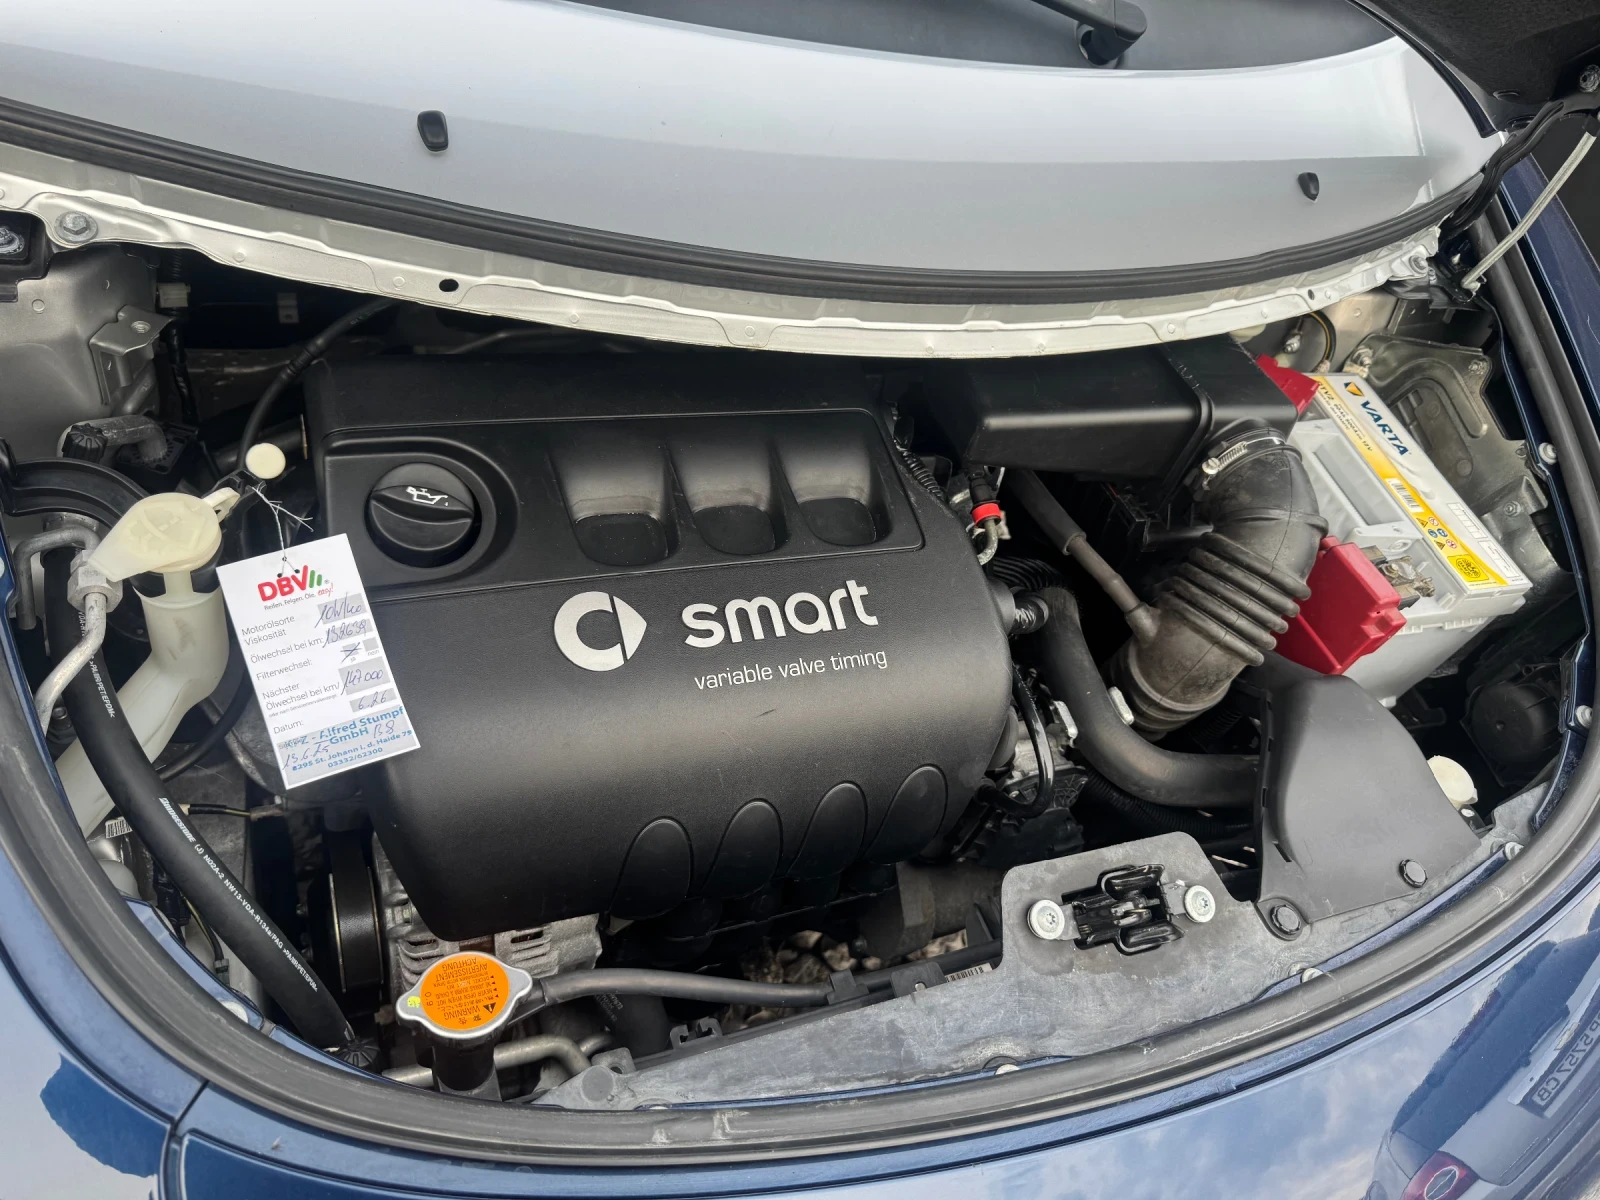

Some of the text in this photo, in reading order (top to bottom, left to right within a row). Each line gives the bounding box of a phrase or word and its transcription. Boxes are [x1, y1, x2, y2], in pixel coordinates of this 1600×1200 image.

[1360, 400, 1410, 456] VARTA
[257, 565, 309, 602] DBV
[284, 596, 304, 606] Felgen.
[317, 583, 334, 597] easy!
[242, 615, 296, 636] Motorölsorte
[682, 580, 878, 648] smart
[244, 628, 287, 646] Viskosität
[250, 636, 324, 664] Ölwechsel bei km:
[256, 658, 312, 681] Filterwechsel:
[694, 650, 888, 690] variable valve timing
[262, 682, 300, 700] Nächster
[266, 682, 340, 711] Ölwechsel bei km/
[273, 720, 304, 735] Datum:
[320, 721, 358, 740] Alfred
[359, 706, 404, 727] Stumpf
[330, 727, 369, 745] GmbH
[292, 762, 314, 772] 8295
[315, 756, 327, 765] St.
[328, 746, 359, 761] Johann
[376, 734, 400, 746] Haide
[328, 747, 384, 768] 03332/62300
[158, 797, 196, 843] BRIDGESTONE
[194, 844, 204, 854] (J)
[436, 962, 488, 982] AVERTISSEMENT
[442, 957, 477, 972] ACHTUNG
[444, 1005, 480, 1020] WARNING
